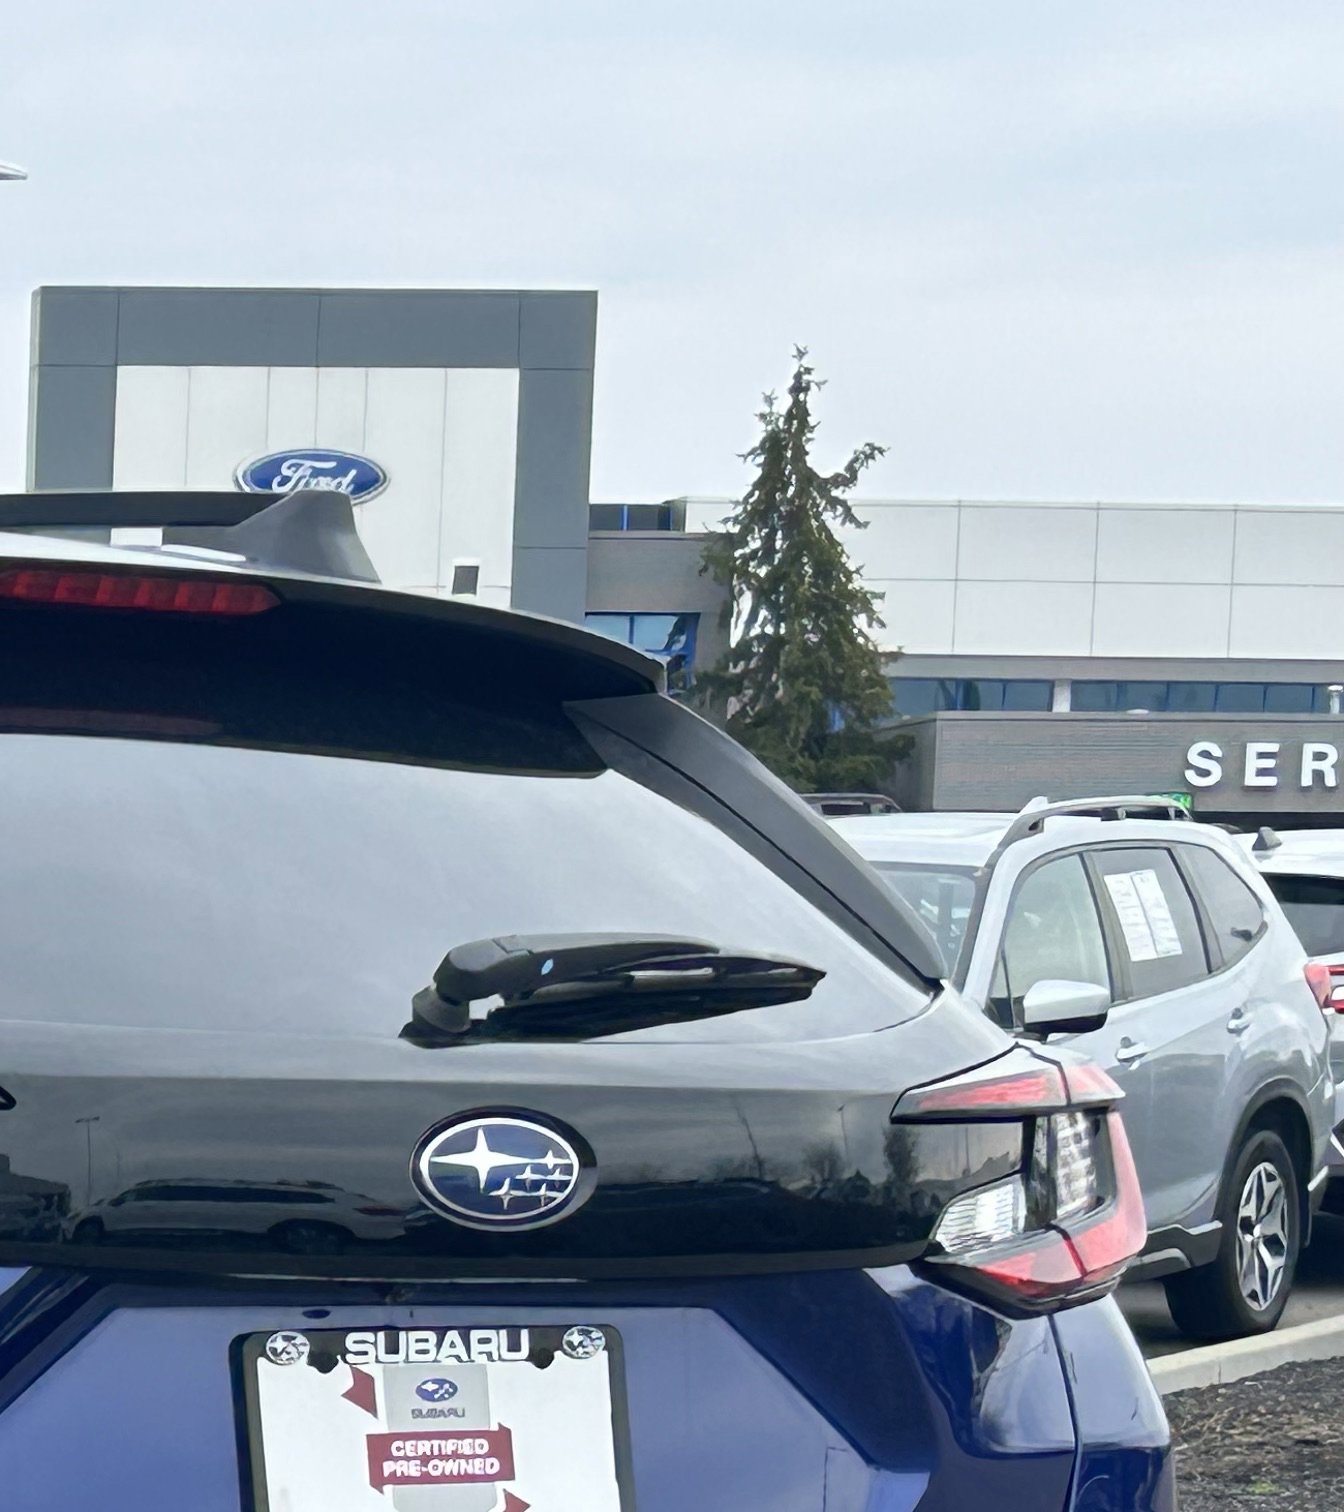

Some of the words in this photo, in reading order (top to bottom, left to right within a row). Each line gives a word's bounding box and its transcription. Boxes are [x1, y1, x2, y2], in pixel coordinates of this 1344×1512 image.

[271, 458, 357, 493] Ford
[1184, 741, 1338, 787] SER
[345, 1328, 530, 1364] SUBARU
[390, 1438, 490, 1457] CERTIFIED
[382, 1457, 501, 1478] PRE-OWNED
